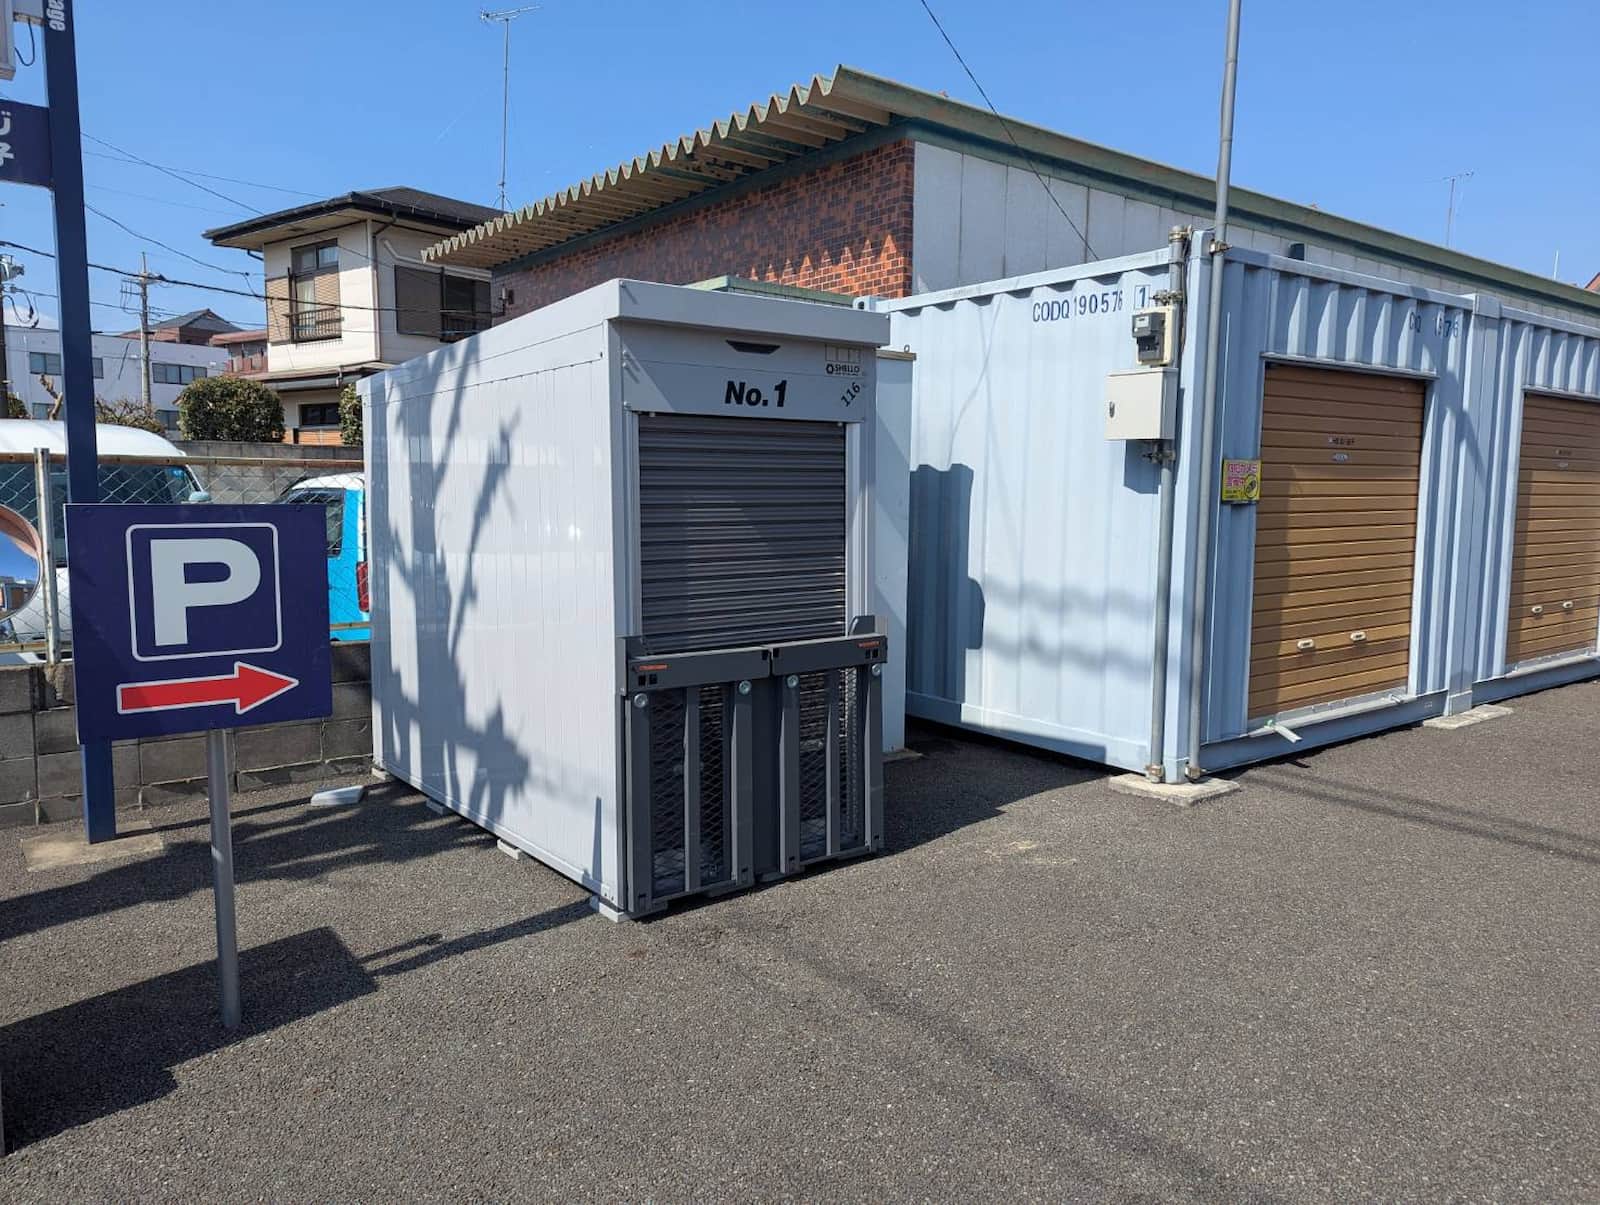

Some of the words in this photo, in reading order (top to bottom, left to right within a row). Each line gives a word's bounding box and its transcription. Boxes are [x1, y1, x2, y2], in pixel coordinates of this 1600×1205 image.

[46, 0, 66, 31] age
[1032, 299, 1070, 322] CODQ
[1139, 287, 1146, 308] 1
[841, 381, 860, 407] 116
[150, 538, 261, 646] P
